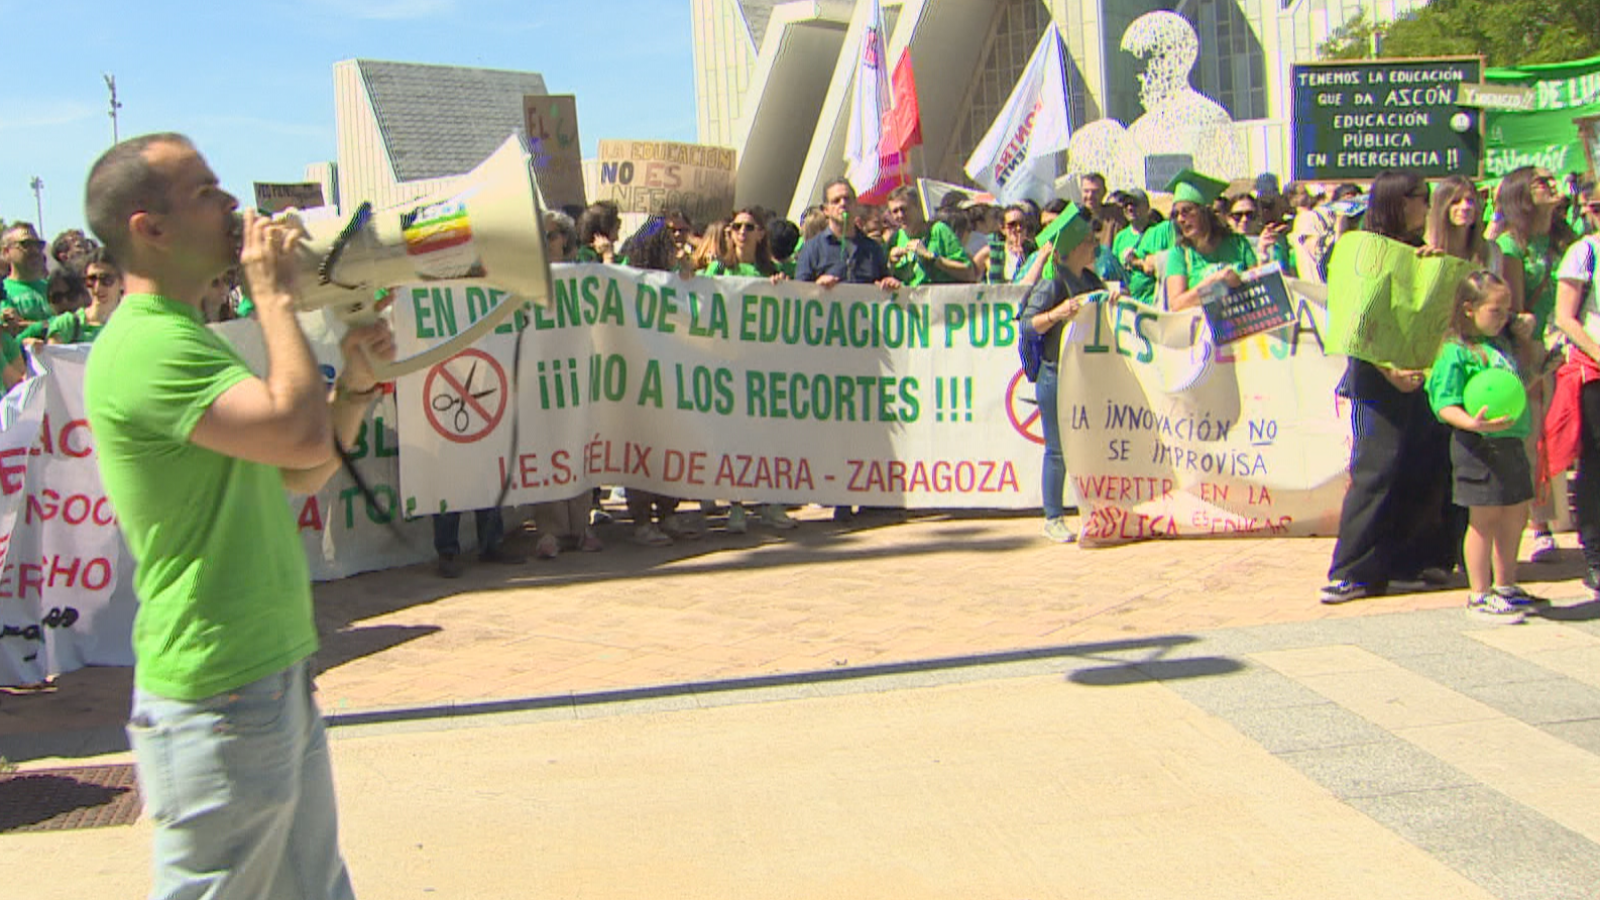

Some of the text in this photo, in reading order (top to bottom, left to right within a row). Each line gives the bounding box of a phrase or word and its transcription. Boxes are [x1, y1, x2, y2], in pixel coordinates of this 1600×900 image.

[1299, 66, 1464, 86] TENEMOS LA EDUCACIÓN
[1317, 93, 1342, 107] QUE
[1354, 93, 1373, 106] DA
[1334, 110, 1429, 129] EDUCACIÓN
[1342, 129, 1412, 148] PÚBLICA
[1306, 152, 1327, 167] EN
[1337, 150, 1440, 168] EMERGENCIA
[601, 161, 634, 186] NO
[645, 162, 683, 189] ES
[411, 286, 458, 339] EN
[635, 282, 678, 333] DE
[688, 291, 729, 339] LA
[740, 292, 930, 349] EDUCACIÓN
[1084, 292, 1158, 363] IES
[637, 359, 664, 410] A
[675, 363, 735, 416] LOS
[746, 370, 920, 424] RECORTES
[935, 375, 974, 423] !!!
[1071, 404, 1090, 430] LA
[1249, 418, 1278, 442] NO
[1108, 440, 1130, 461] SE
[663, 448, 707, 487] DE
[714, 454, 815, 491] AZARA
[846, 458, 1020, 494] ZARAGOZA
[1199, 482, 1229, 504] EN
[1248, 484, 1272, 506] LA
